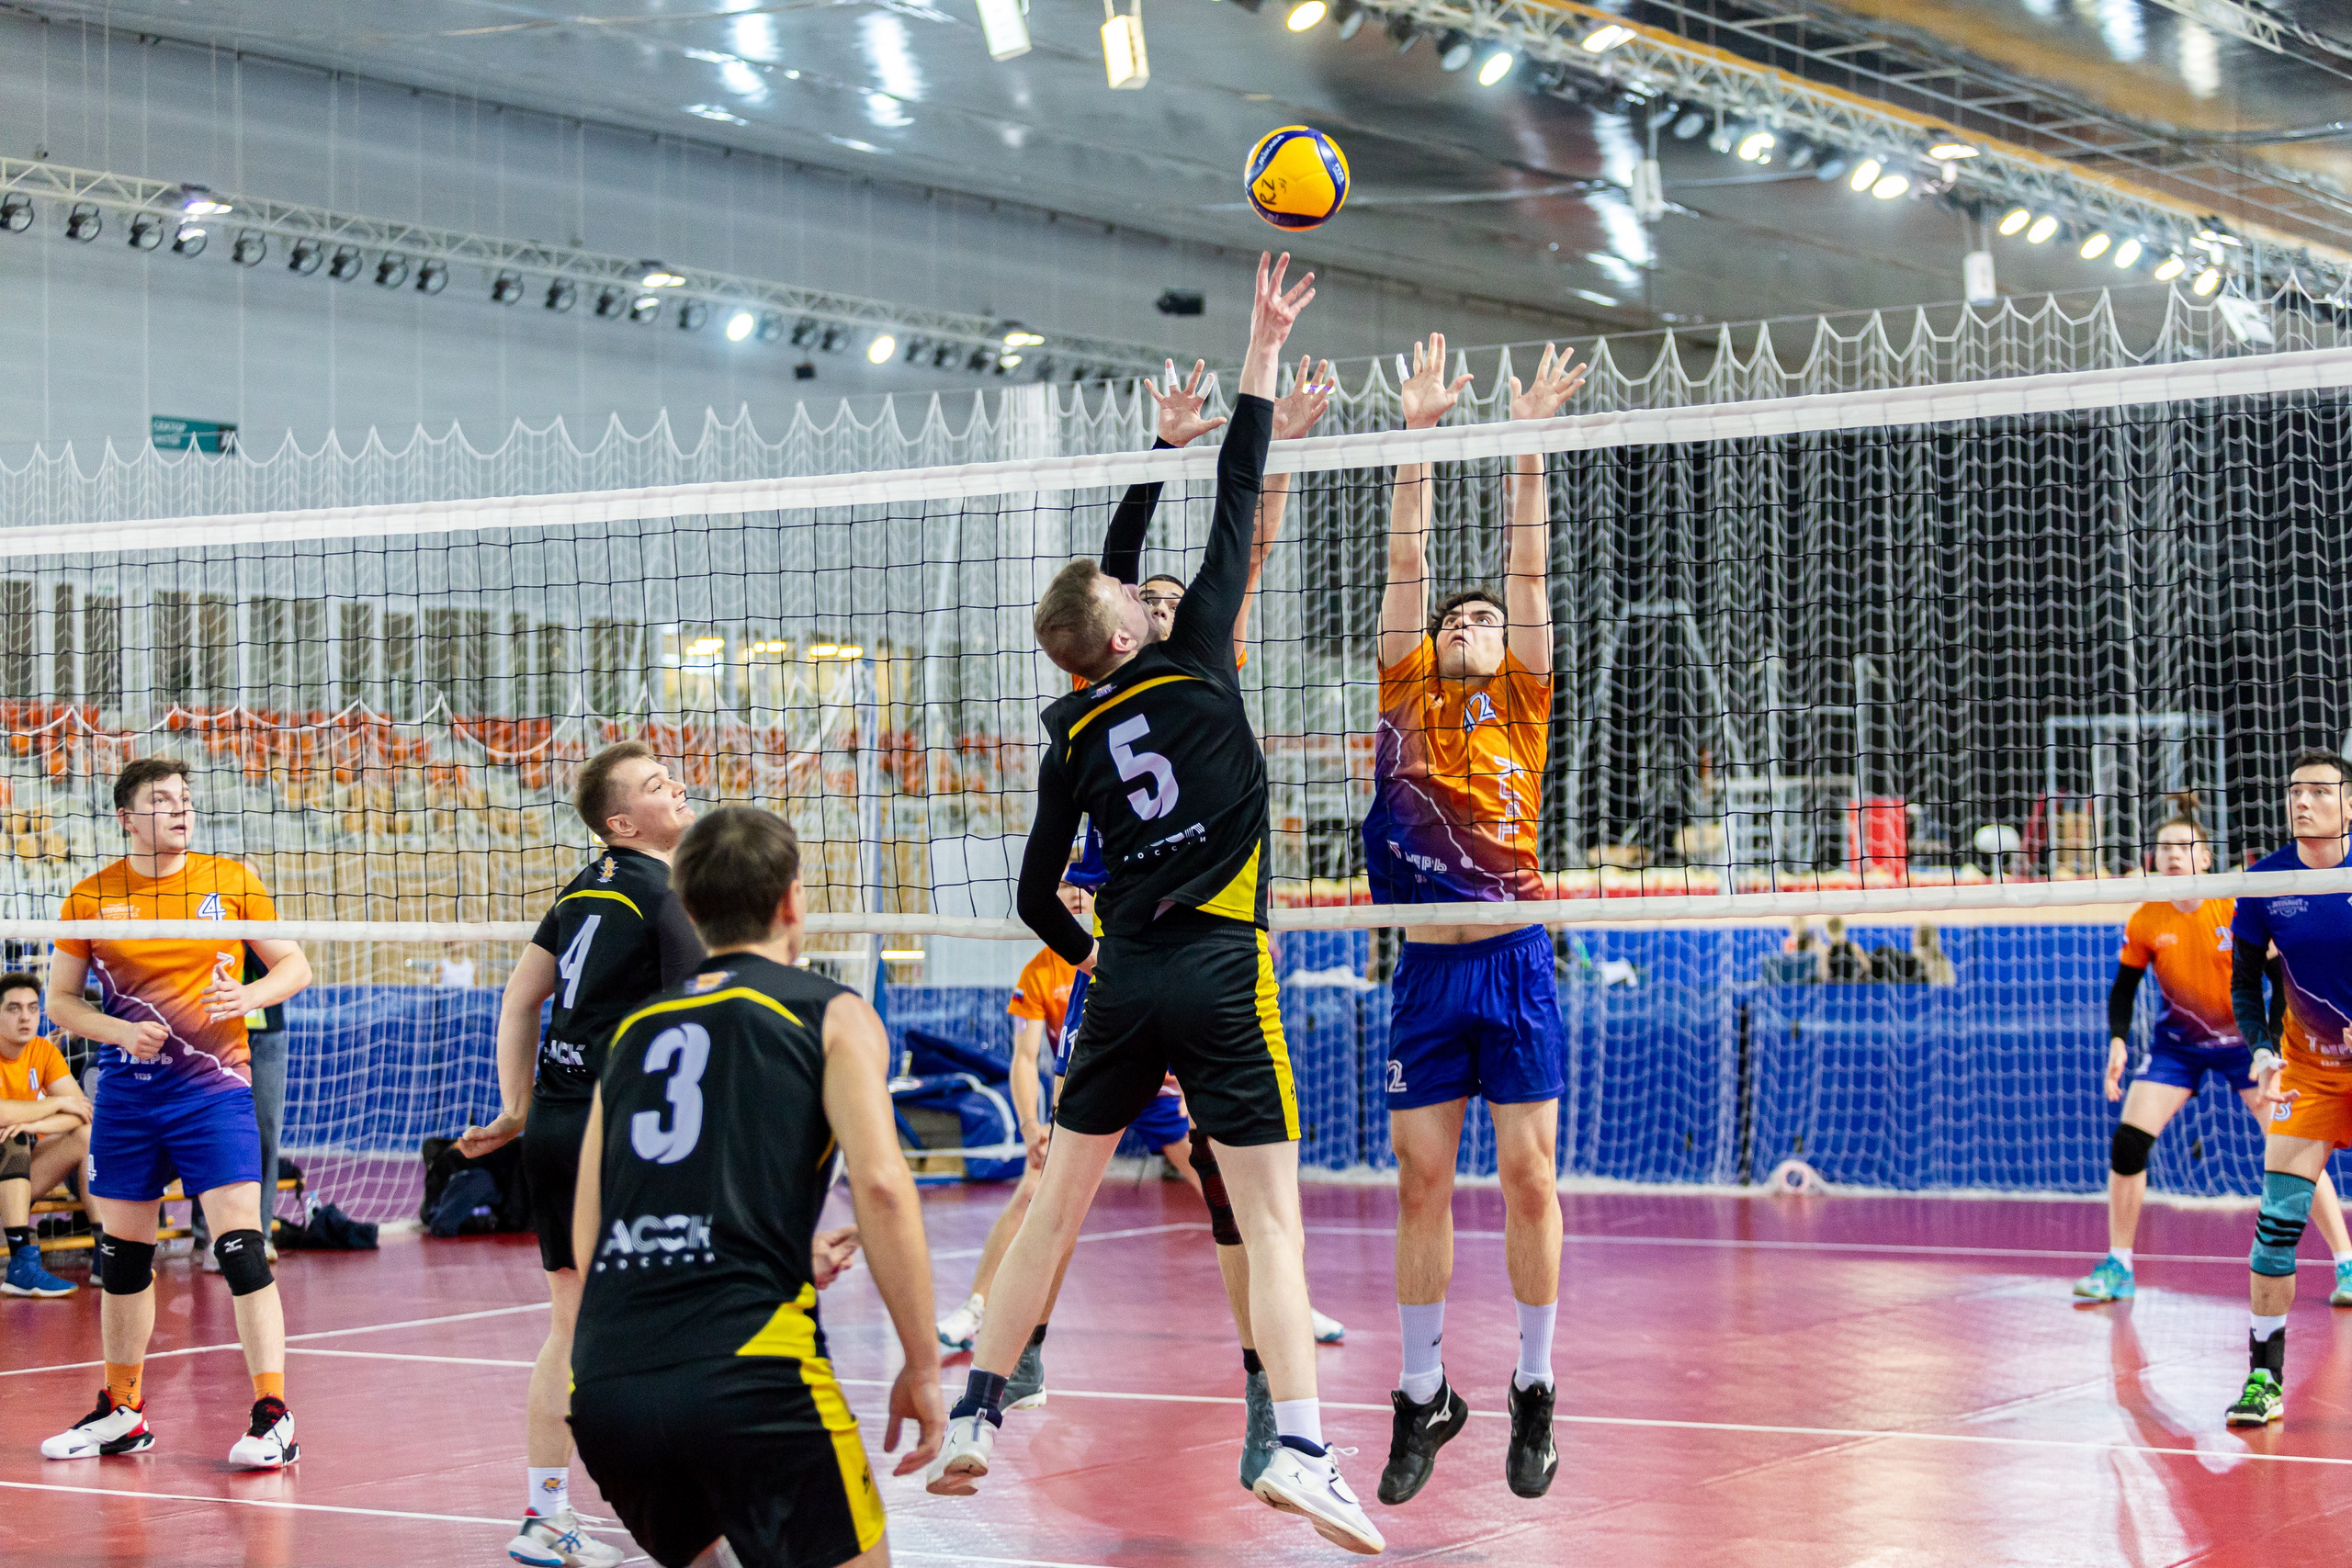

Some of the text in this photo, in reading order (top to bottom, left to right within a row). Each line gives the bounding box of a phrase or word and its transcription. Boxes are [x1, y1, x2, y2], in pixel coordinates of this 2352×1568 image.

[1109, 713, 1179, 820] 5
[1124, 836, 1206, 862] РОССИ
[197, 892, 226, 920] 4
[559, 914, 601, 1009] 4
[630, 1022, 710, 1164] 3
